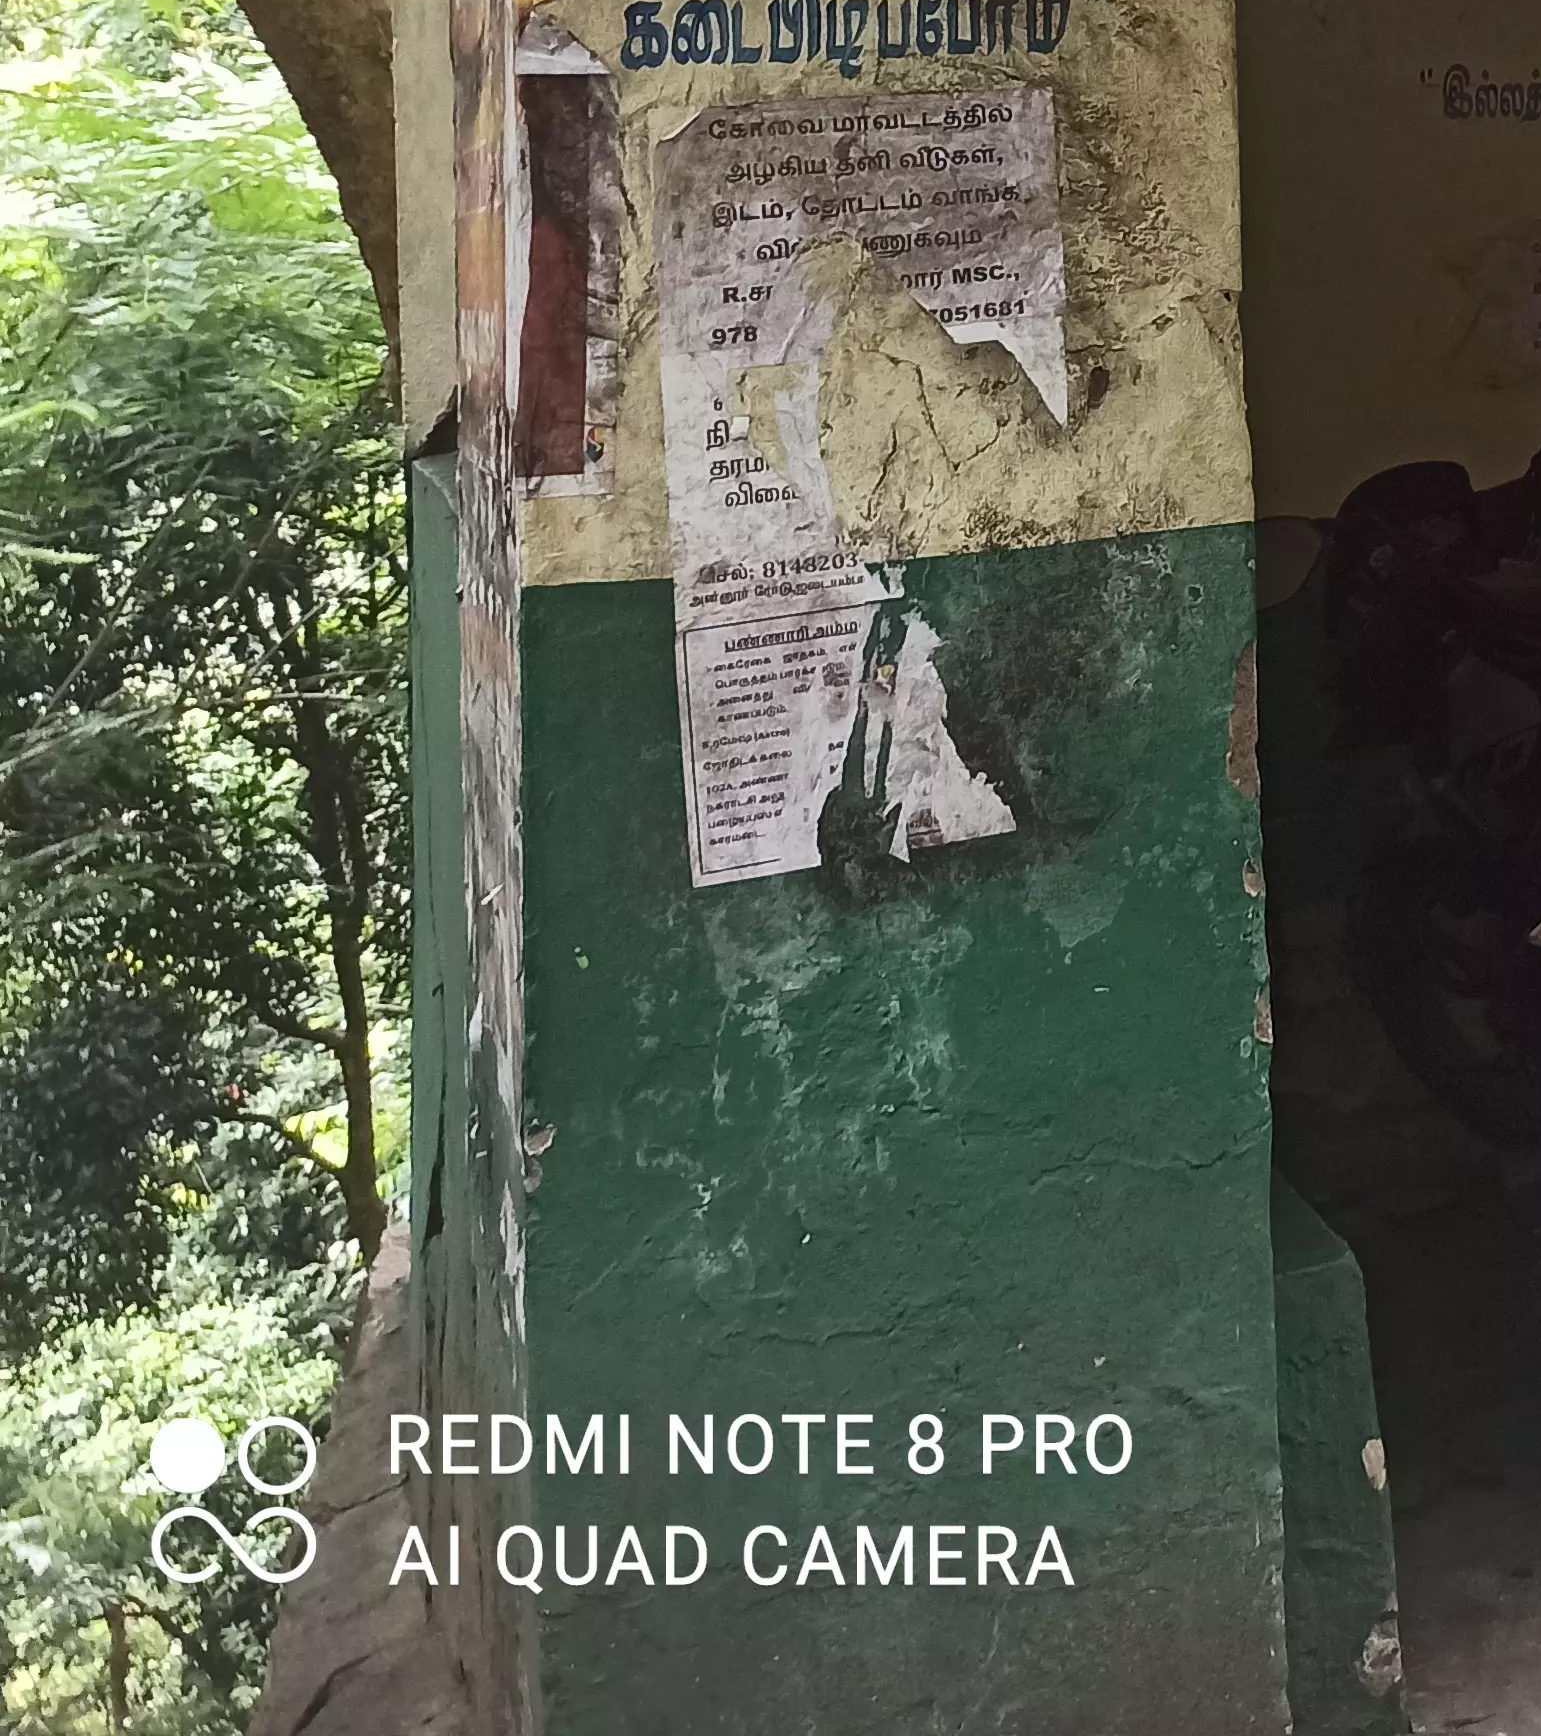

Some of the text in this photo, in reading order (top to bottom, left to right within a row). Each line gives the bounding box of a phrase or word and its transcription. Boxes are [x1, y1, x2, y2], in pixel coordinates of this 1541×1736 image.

[708, 117, 824, 141] கோவை
[726, 156, 828, 184] அழகிய
[835, 149, 891, 178] தனி
